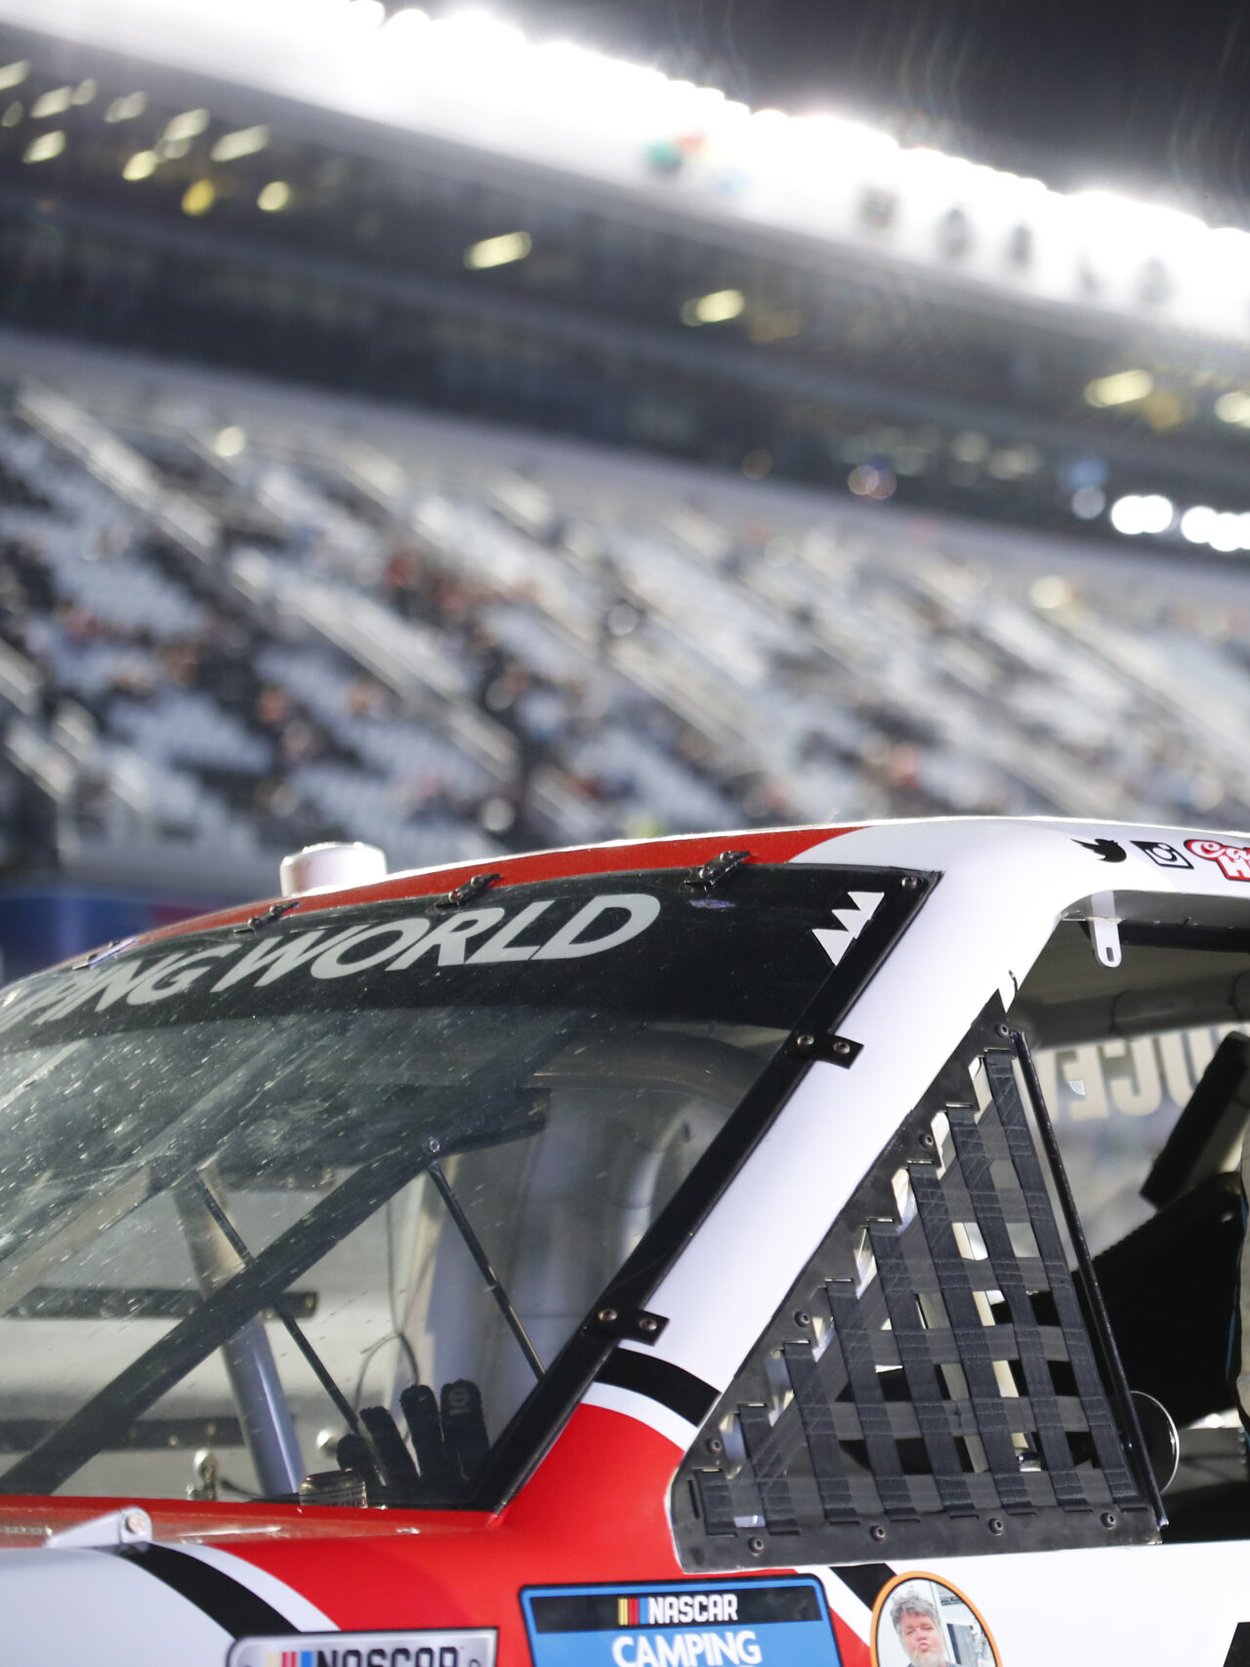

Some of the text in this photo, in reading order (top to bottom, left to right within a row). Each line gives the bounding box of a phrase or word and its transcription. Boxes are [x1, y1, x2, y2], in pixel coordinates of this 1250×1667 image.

[210, 892, 661, 993] WORLD
[648, 1594, 738, 1624] NASCAR
[612, 1630, 763, 1667] CAMPING
